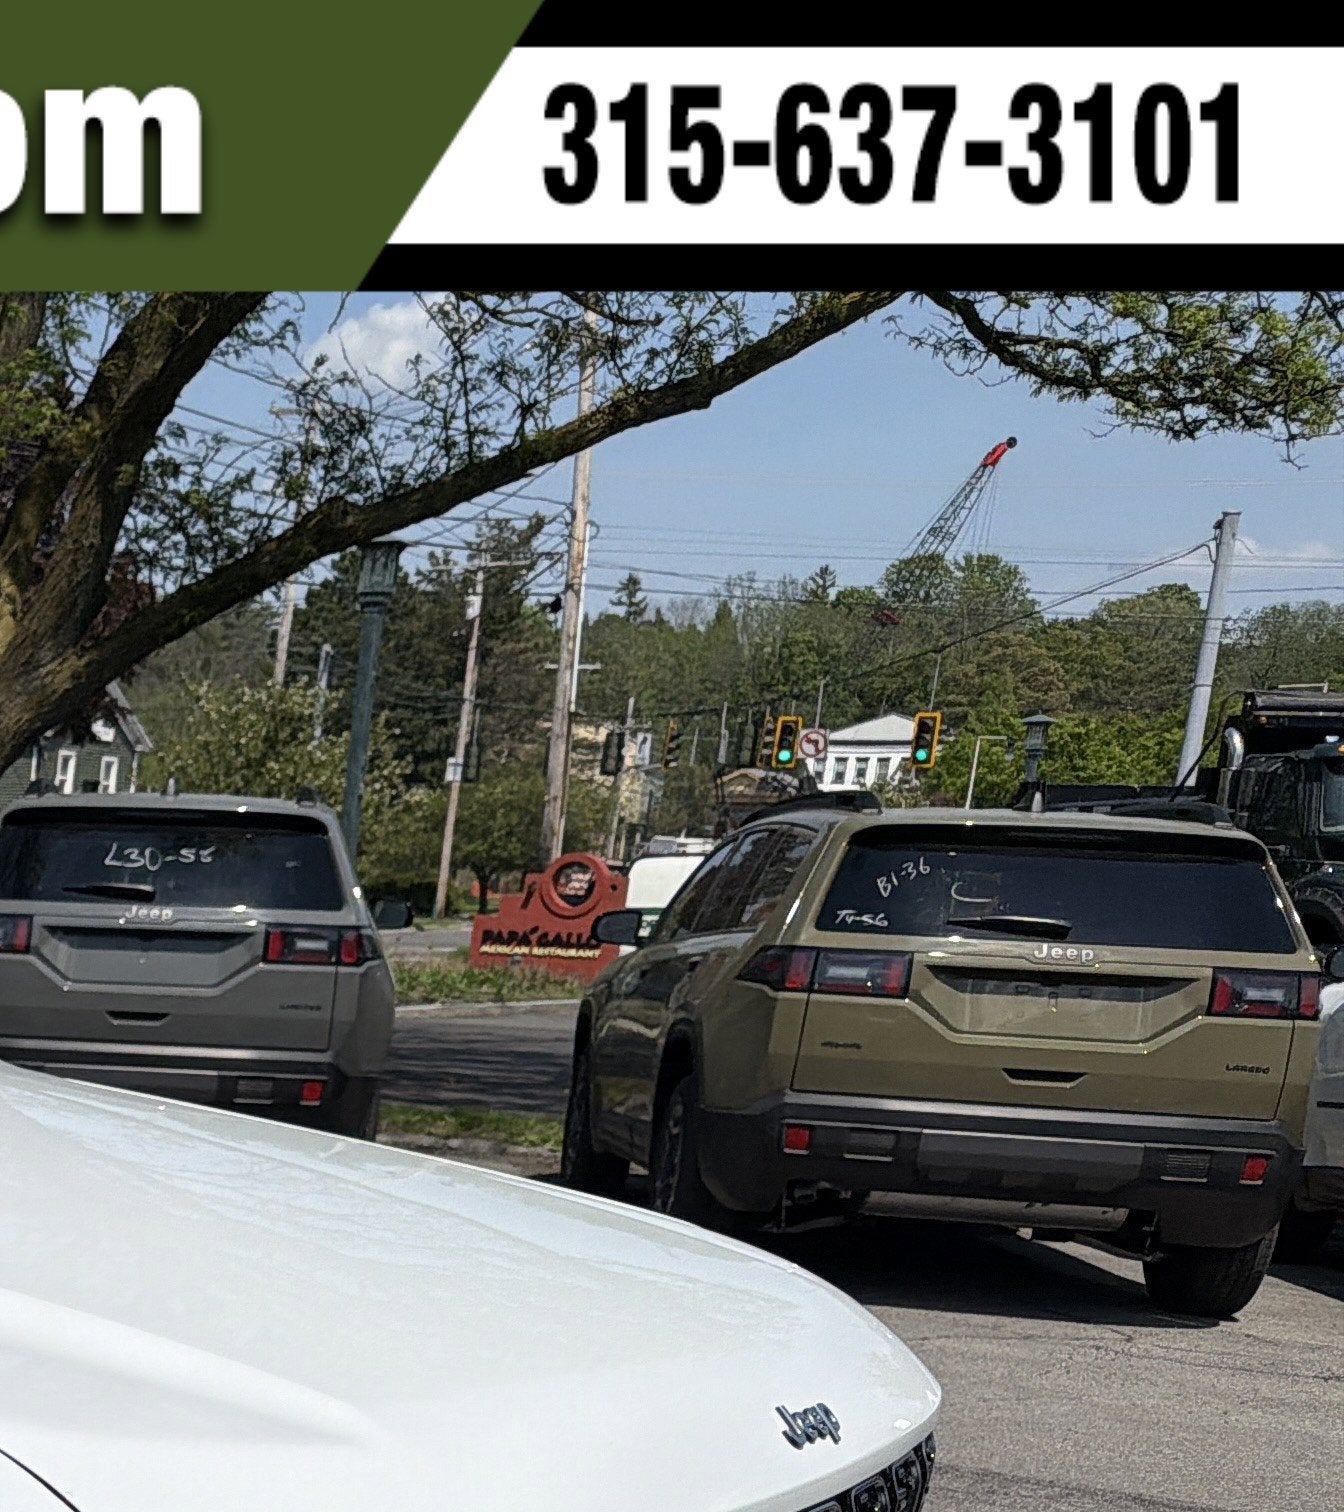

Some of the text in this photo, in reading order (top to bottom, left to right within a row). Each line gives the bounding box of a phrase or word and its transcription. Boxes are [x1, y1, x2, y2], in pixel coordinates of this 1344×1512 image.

[124, 904, 173, 922] Jeep
[1033, 943, 1094, 963] Jeep
[774, 1402, 842, 1451] Jeep
